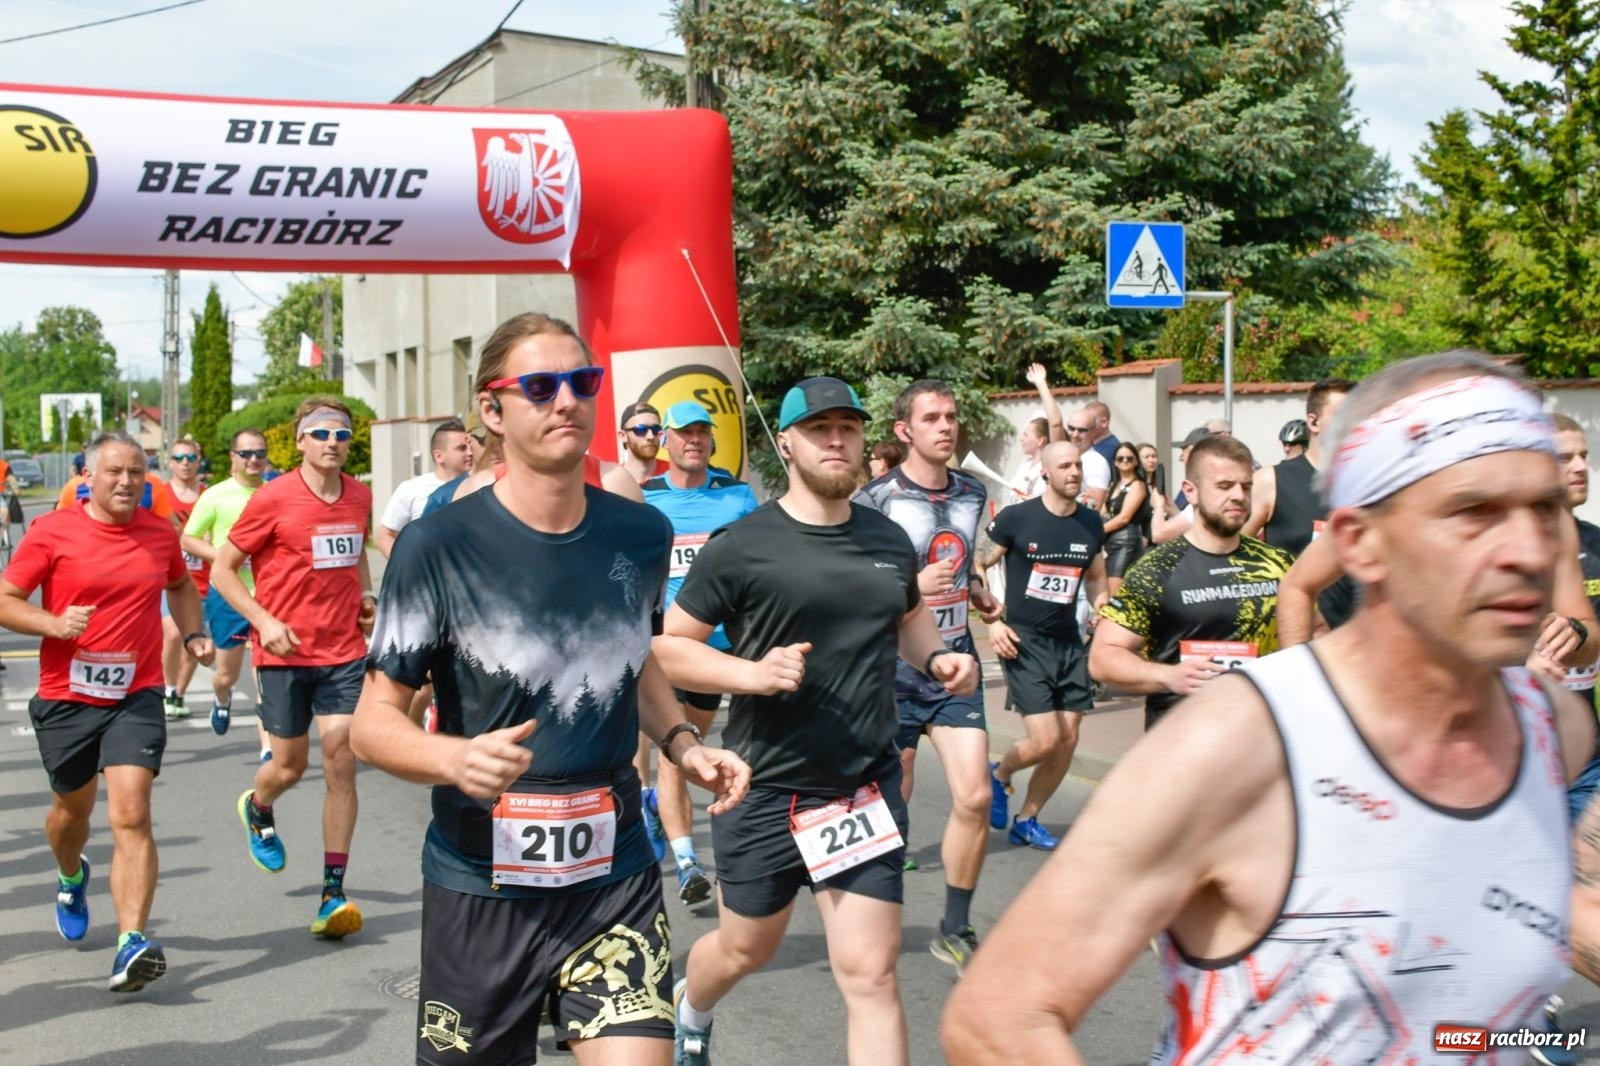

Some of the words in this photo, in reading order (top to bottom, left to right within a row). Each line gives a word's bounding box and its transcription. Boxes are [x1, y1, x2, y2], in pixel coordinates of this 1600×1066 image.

[14, 124, 93, 153] SIR
[225, 118, 340, 146] BIEG
[136, 160, 242, 195] BEZ
[249, 165, 428, 199] GRANIC
[158, 210, 403, 245] RACIBÓRZ
[692, 385, 741, 415] SIR
[326, 537, 353, 555] 161
[675, 548, 703, 565] 19
[1041, 576, 1069, 593] 231
[1181, 580, 1278, 604] RUNMAGEDDON
[931, 607, 955, 628] 71
[84, 665, 125, 686] 142
[521, 822, 593, 862] 210
[820, 812, 876, 855] 221
